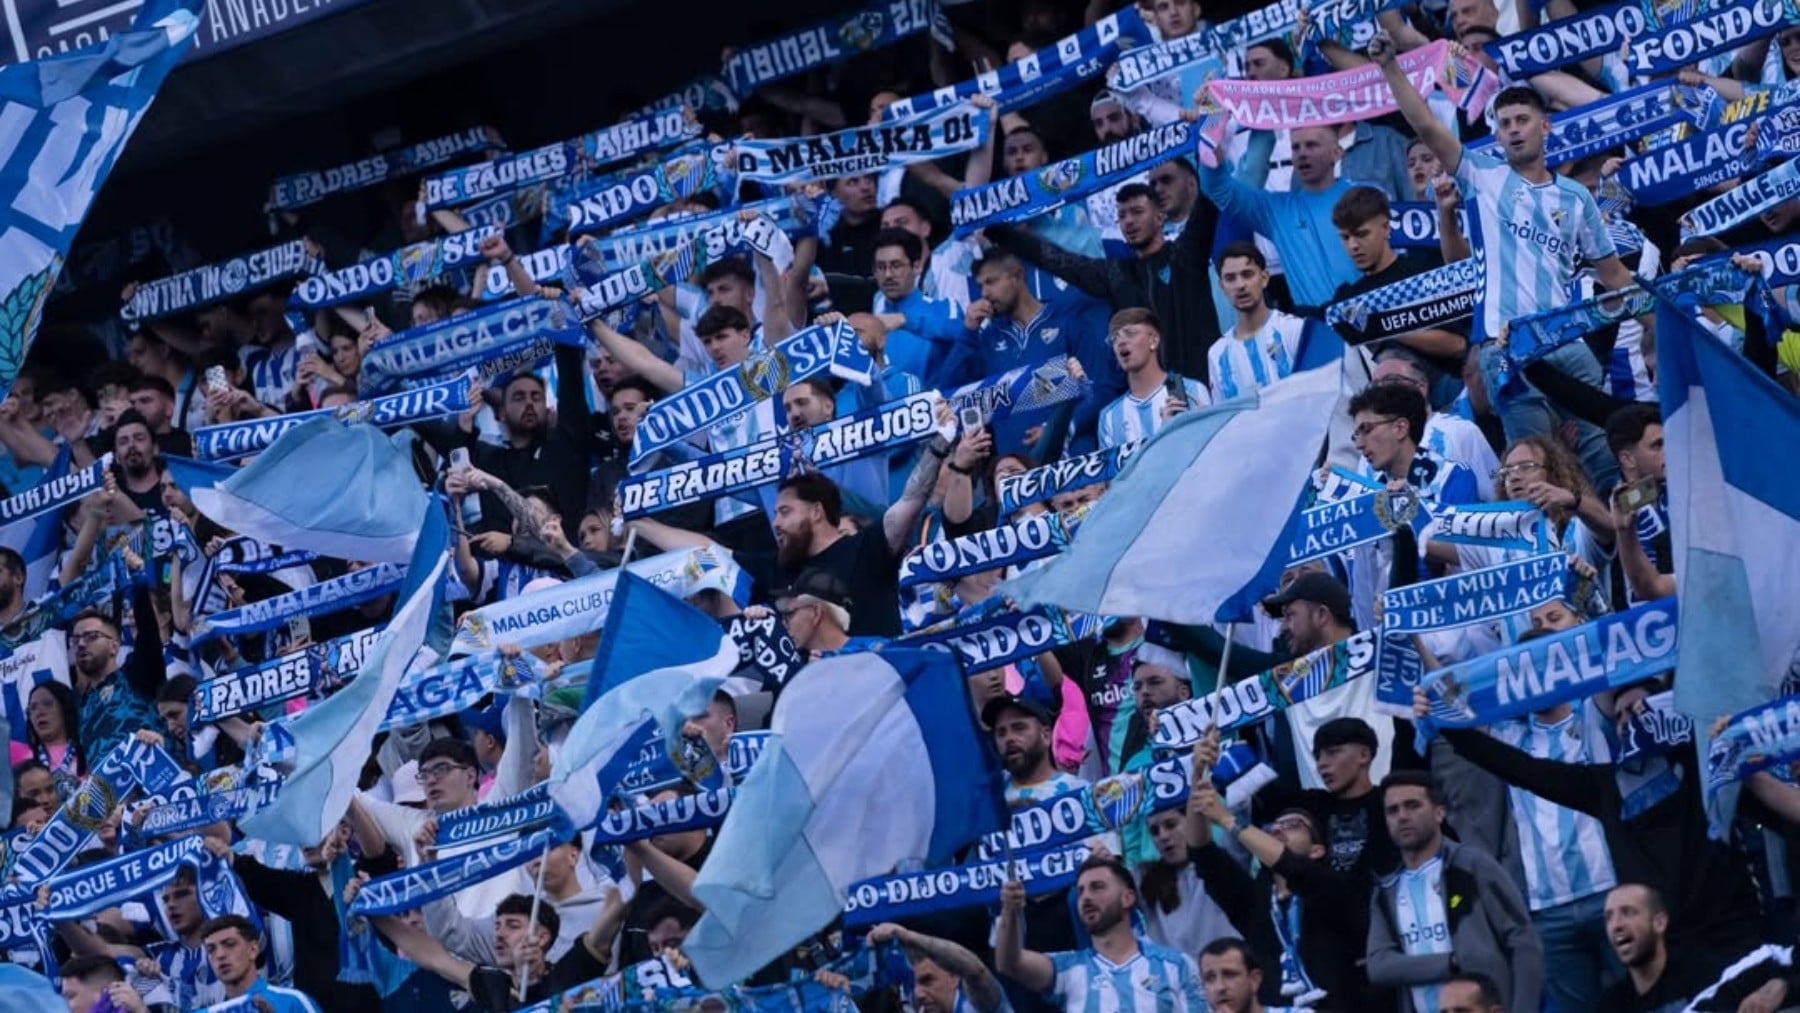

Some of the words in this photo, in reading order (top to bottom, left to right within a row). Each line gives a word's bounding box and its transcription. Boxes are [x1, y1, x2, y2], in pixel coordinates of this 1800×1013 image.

[1500, 5, 1645, 73] FONDO
[1632, 0, 1783, 70] FONDO
[427, 177, 457, 204] DE
[464, 144, 567, 193] PADRES
[620, 109, 692, 153] HIJO
[766, 123, 933, 174] MALAKA
[810, 154, 890, 176] HINCHAS
[1095, 123, 1191, 177] HINCHAS
[1630, 123, 1749, 190] MALAG
[1693, 170, 1725, 190] SINCE
[371, 320, 496, 373] MALAGA
[502, 304, 542, 338] CF
[1381, 312, 1418, 332] UEFA
[375, 386, 449, 421] SUR
[623, 479, 662, 513] DE
[665, 447, 781, 498] PADRES
[842, 398, 933, 454] HIJOS
[1307, 499, 1364, 530] LEAL
[1289, 528, 1359, 560] LAGA
[239, 560, 401, 627] MALAGA
[1384, 588, 1427, 609] BLE
[1435, 583, 1452, 600] Y
[1457, 567, 1510, 598] MUY
[492, 602, 562, 635] MALAGA
[562, 593, 601, 618] CLUB
[1412, 604, 1446, 627] DE
[1497, 609, 1677, 706] MALAG
[211, 656, 311, 715] PADRES
[449, 807, 528, 839] CIUDAD
[122, 860, 143, 881] TE
